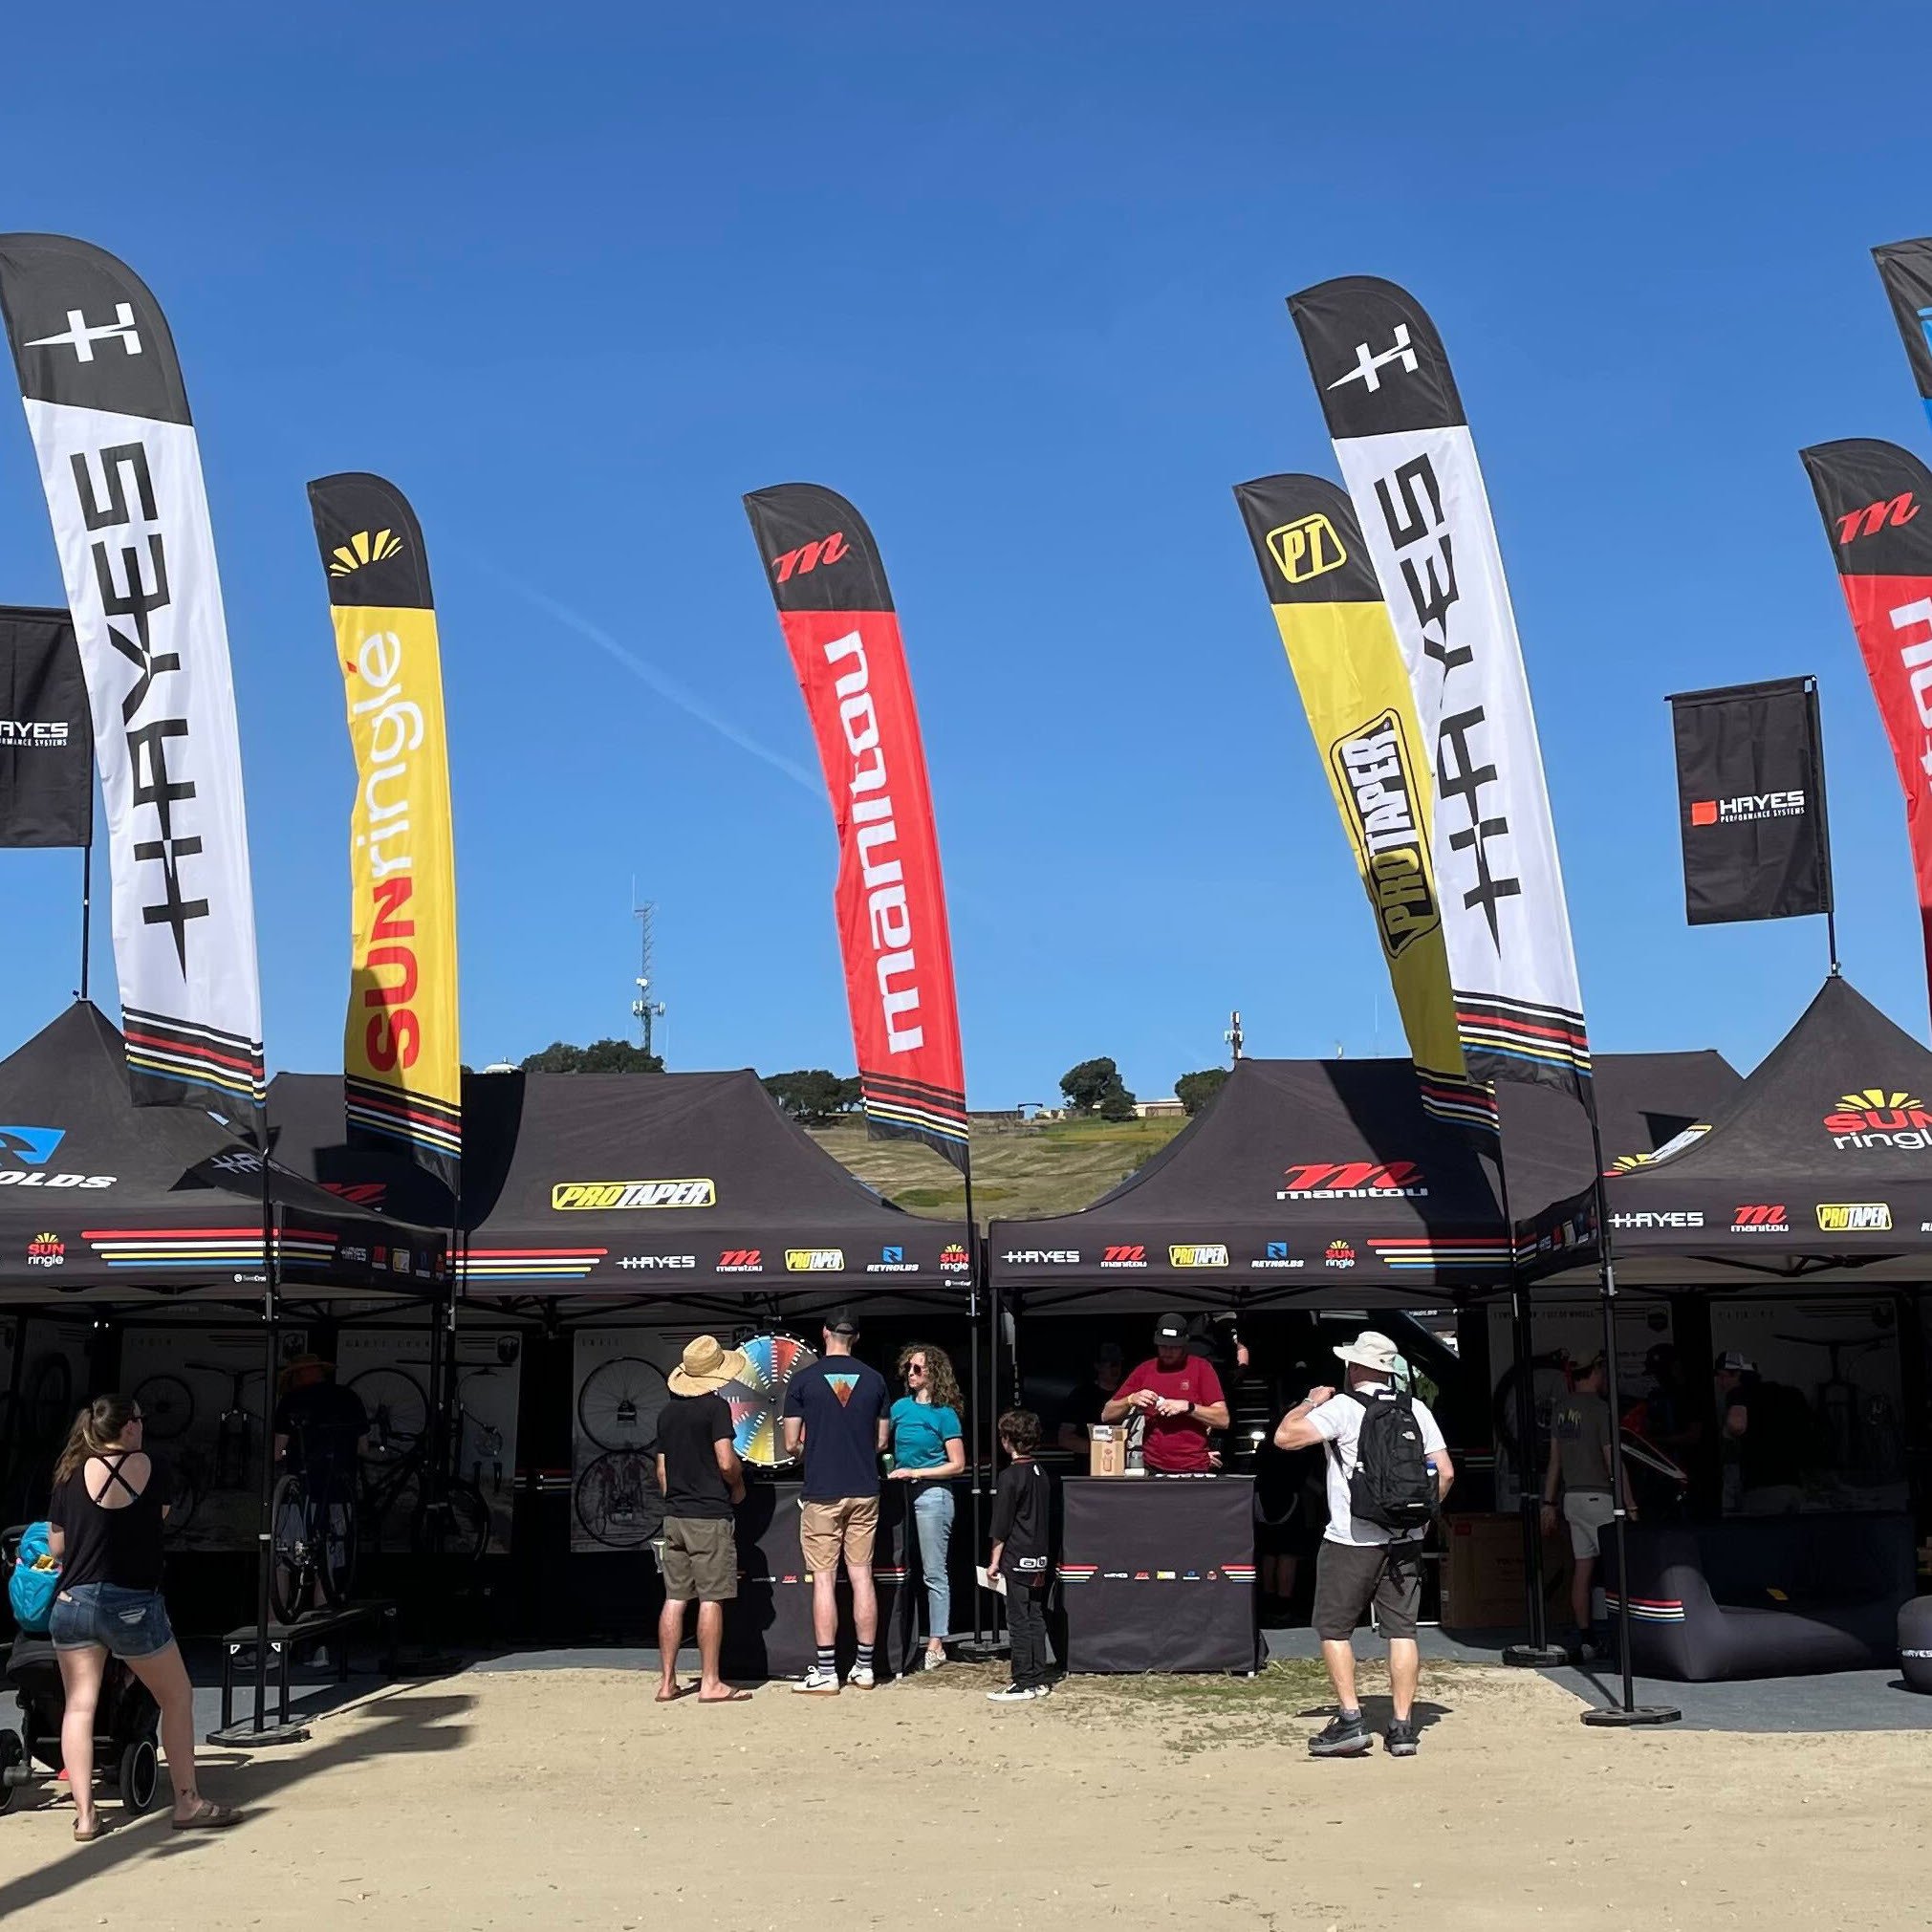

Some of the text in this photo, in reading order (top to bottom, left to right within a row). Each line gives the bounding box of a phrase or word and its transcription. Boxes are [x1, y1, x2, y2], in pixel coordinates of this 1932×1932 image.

[1281, 517, 1327, 582] PT
[70, 442, 209, 984] HAYES
[1373, 453, 1521, 961] HAYES
[1720, 790, 1805, 814] HAYES
[1773, 807, 1805, 817] SYSTEMS
[1340, 728, 1433, 939] PROTAPER
[823, 630, 924, 1054] manitou
[556, 1182, 711, 1208] PROTAPER
[1276, 1187, 1428, 1201] manitou
[1608, 1211, 1704, 1227] HAYES
[1820, 1206, 1888, 1228] PROTAPER
[1730, 1224, 1790, 1232] manitou
[28, 1243, 65, 1254] SUN
[1173, 1247, 1226, 1265] PROTAPER
[1325, 1248, 1355, 1259] SUN
[616, 1255, 696, 1270] HAYES
[788, 1251, 841, 1270] PROTAPER
[940, 1252, 969, 1263] SUN
[1001, 1250, 1080, 1263] HAYES
[715, 1264, 763, 1272] manitou
[866, 1264, 920, 1272] REYNOLDS
[1250, 1260, 1305, 1269] REYNOLDS
